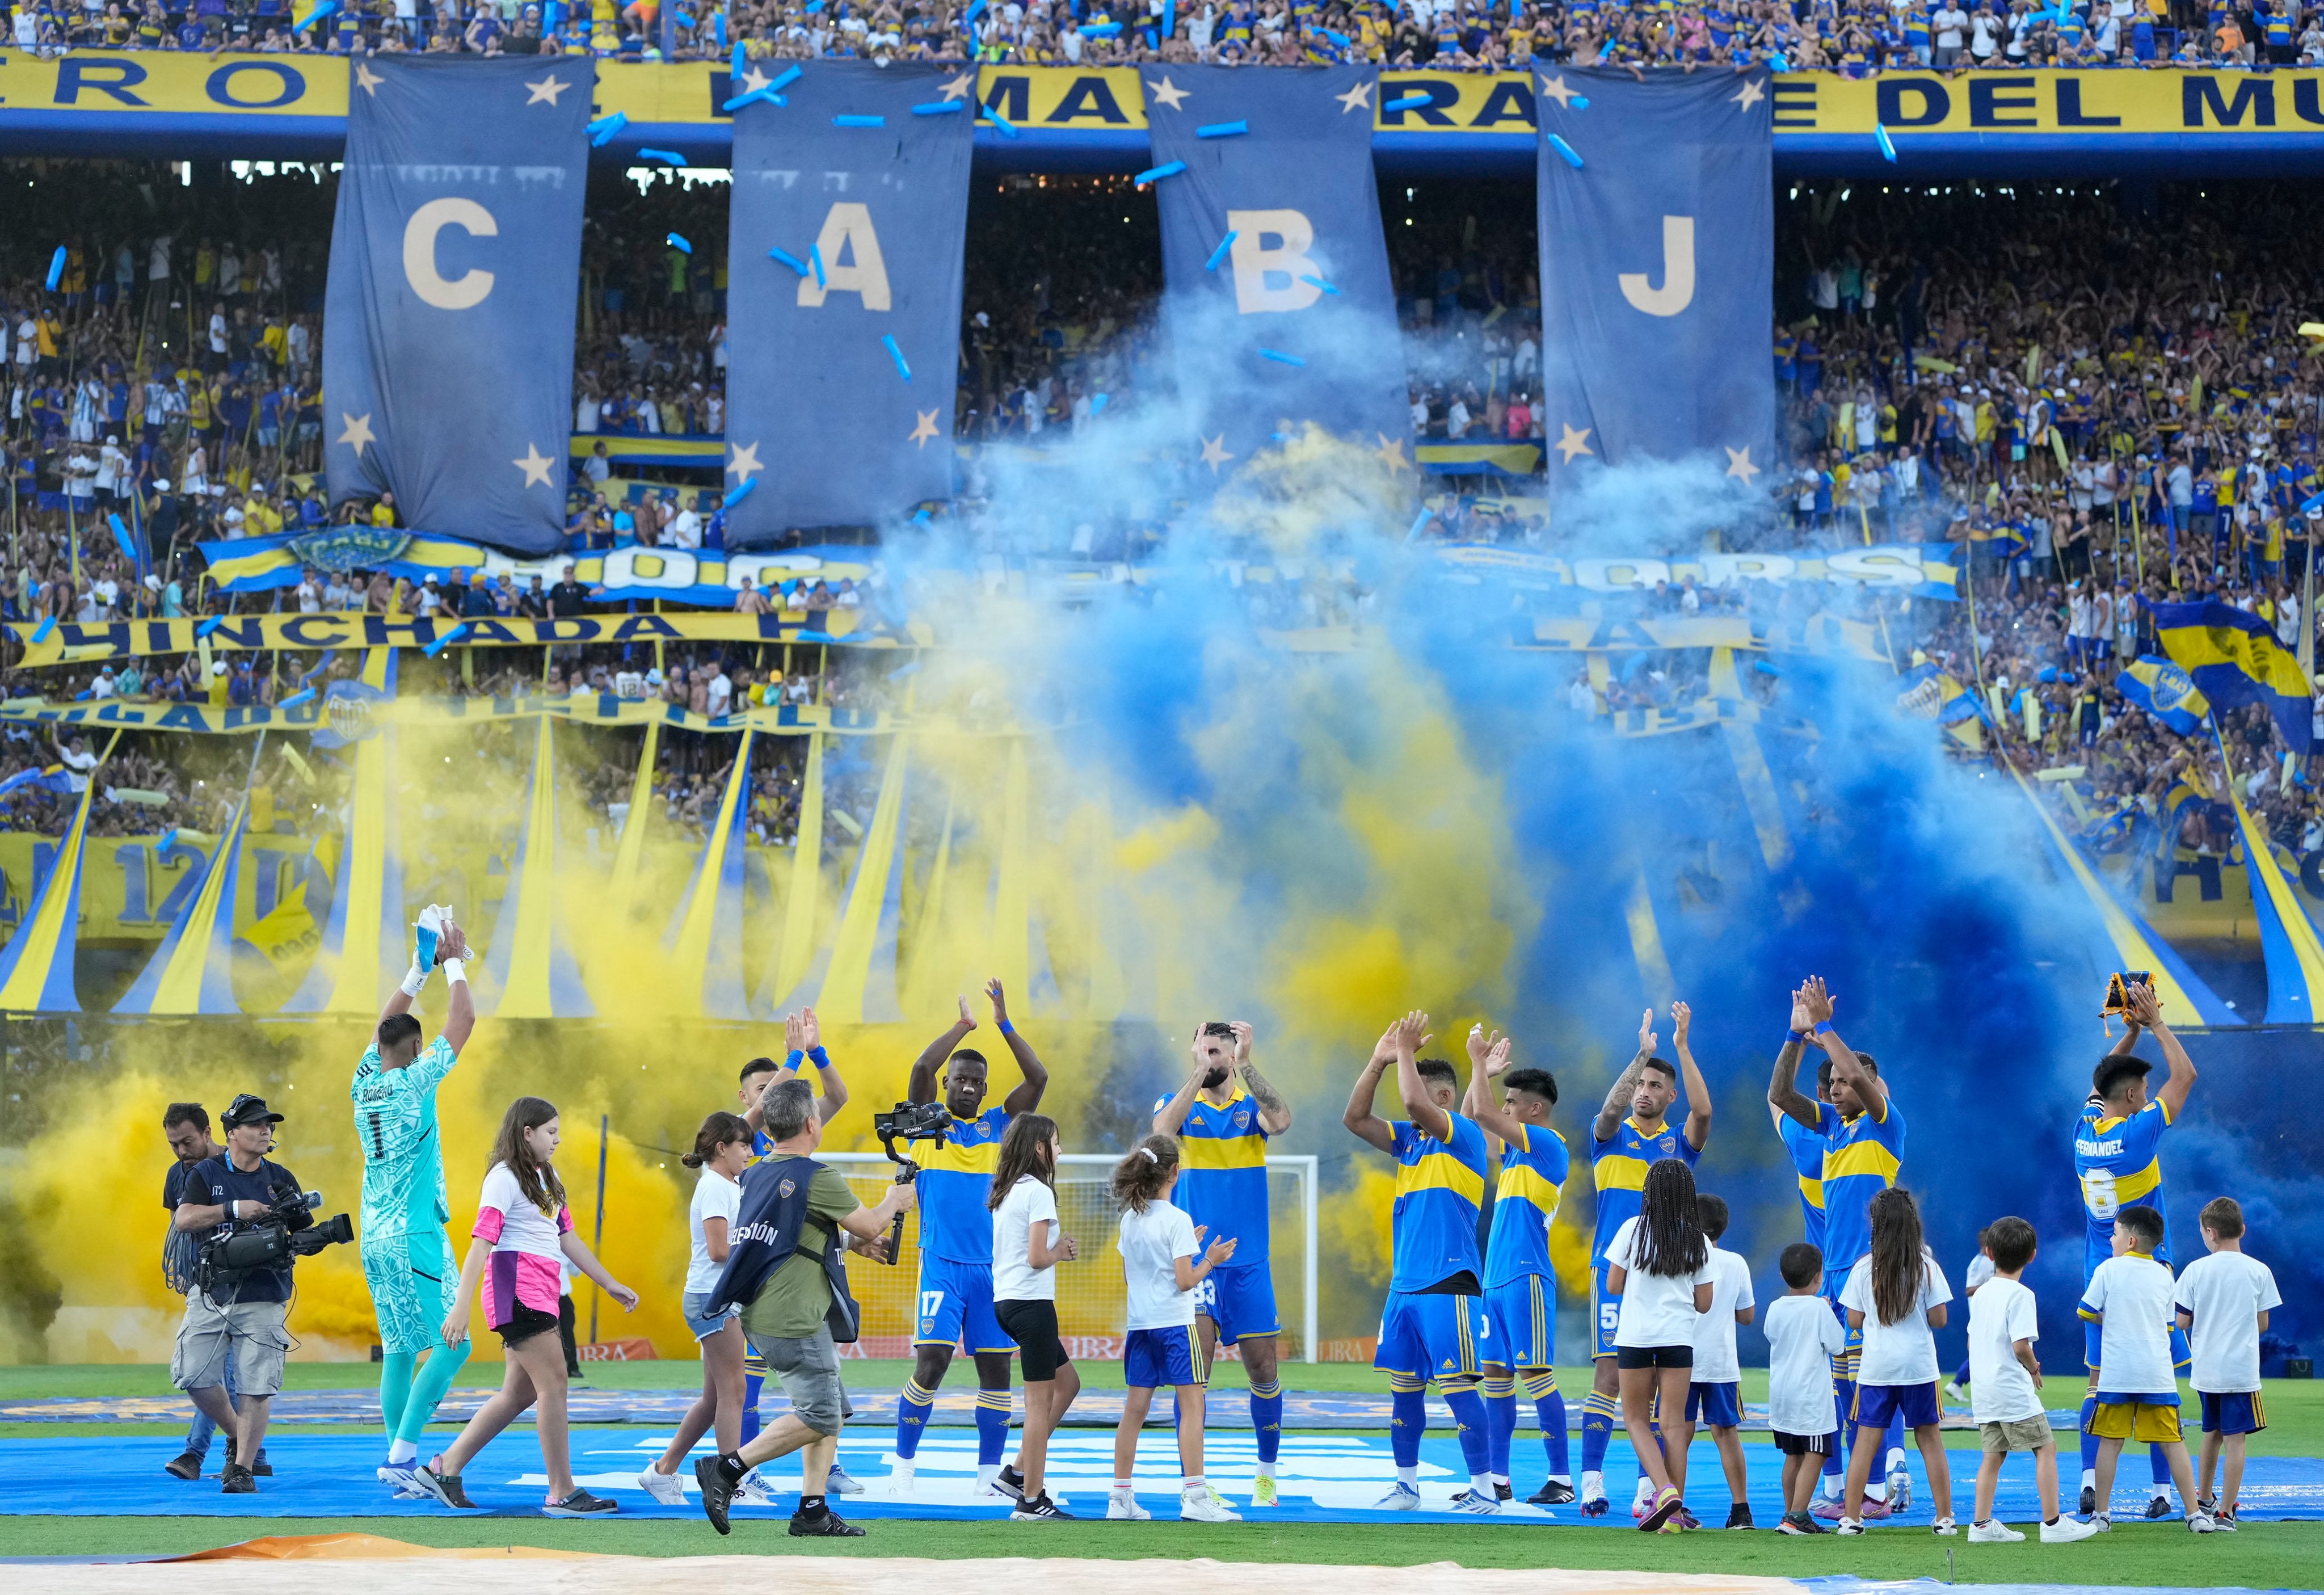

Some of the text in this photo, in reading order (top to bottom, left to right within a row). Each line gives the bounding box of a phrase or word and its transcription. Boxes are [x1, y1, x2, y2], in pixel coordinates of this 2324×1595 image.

[0, 57, 306, 108] RO
[1876, 77, 2121, 128] DEL
[402, 197, 499, 309] C
[797, 202, 892, 312] A
[1227, 208, 1325, 315] B
[1618, 214, 1695, 317] J
[57, 615, 684, 661] HINCHADA
[115, 844, 208, 923] 12
[363, 1084, 393, 1102] ROMERO
[368, 1112, 385, 1159] 1
[904, 1126, 922, 1134] RONIN
[2076, 1138, 2124, 1157] FERNANDEZ
[781, 1184, 793, 1192] CABJ
[2085, 1167, 2120, 1219] 8
[921, 1290, 944, 1317] 17
[1194, 1279, 1216, 1306] 33
[1601, 1303, 1618, 1329] 5
[574, 1337, 1363, 1362] IBRA IBR LIBRA
